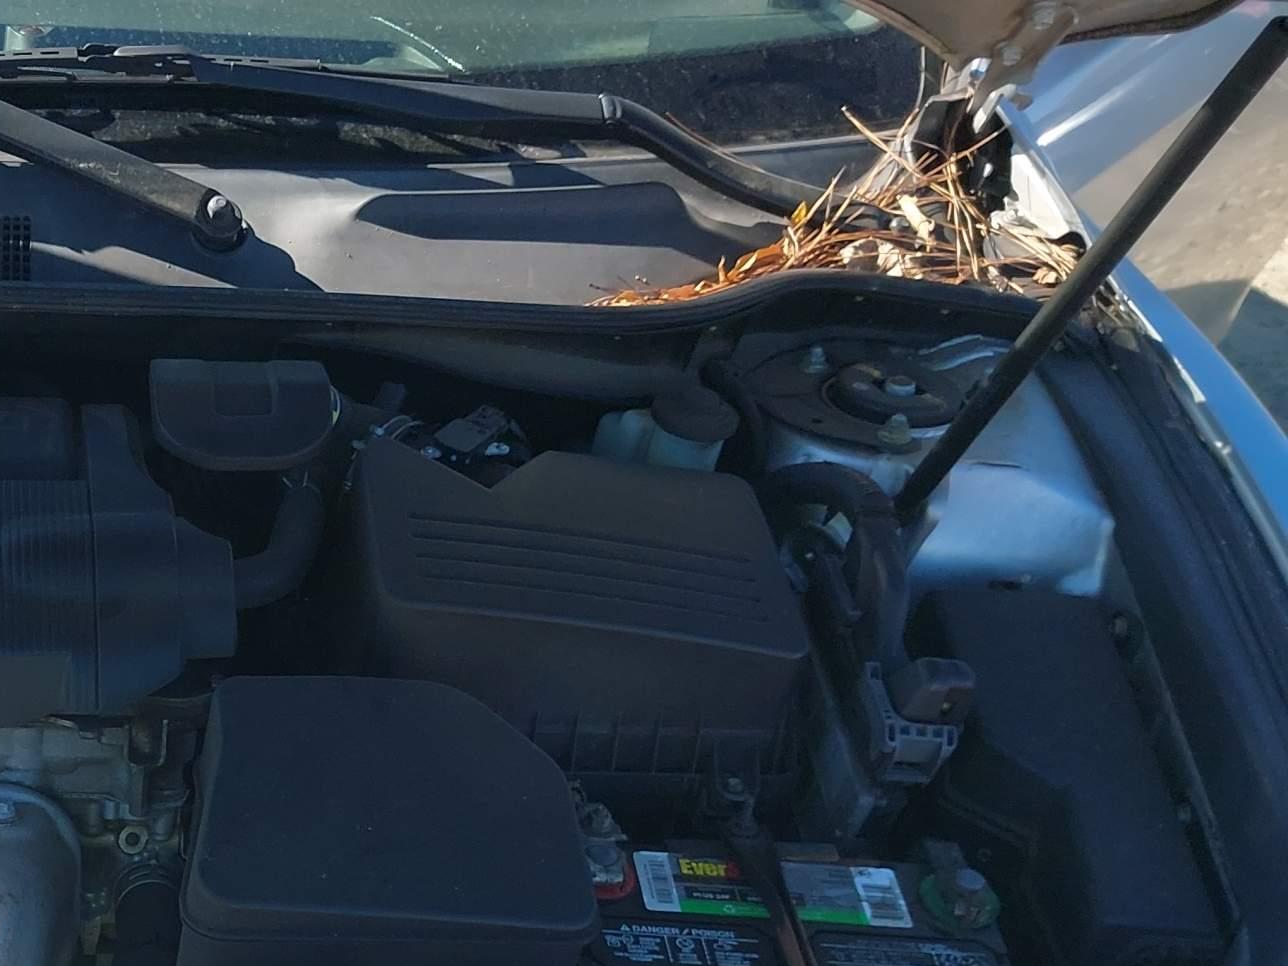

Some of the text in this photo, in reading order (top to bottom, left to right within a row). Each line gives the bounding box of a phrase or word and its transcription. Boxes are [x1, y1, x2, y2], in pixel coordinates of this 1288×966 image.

[679, 858, 741, 879] EverS
[631, 924, 679, 936] DANGER
[692, 927, 735, 939] POISON
